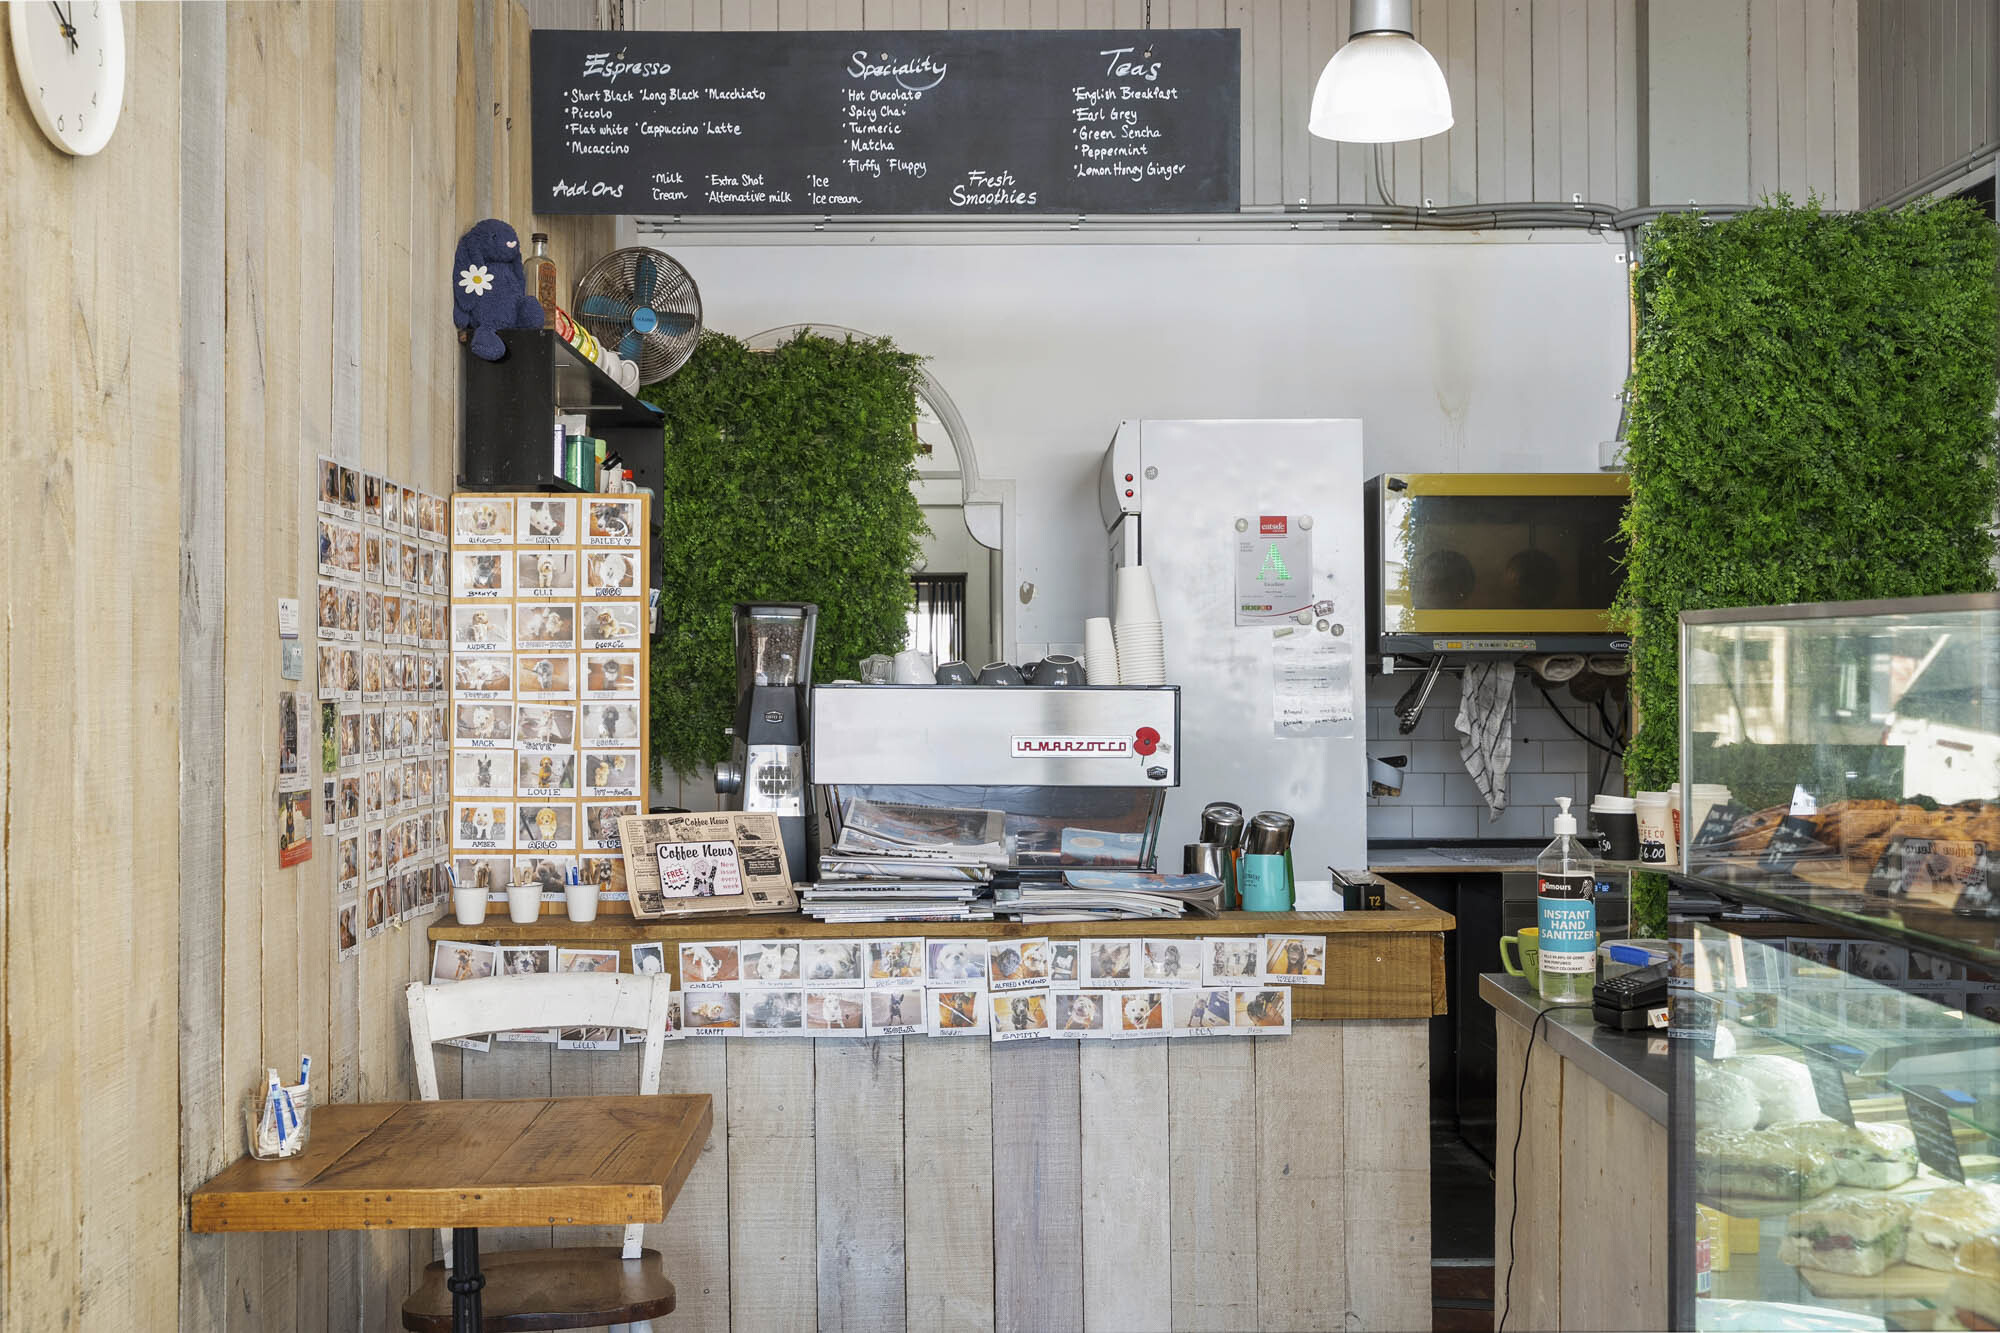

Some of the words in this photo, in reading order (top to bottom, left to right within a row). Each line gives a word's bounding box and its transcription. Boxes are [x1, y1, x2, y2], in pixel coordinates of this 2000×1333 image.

[583, 52, 671, 83] Espresso
[847, 51, 947, 90] Speciality
[1100, 47, 1161, 81] Teas
[571, 89, 600, 103] Short
[603, 90, 633, 102] Black
[641, 89, 666, 105] Long
[670, 88, 699, 100] Black
[709, 88, 765, 100] Macchiato
[849, 89, 865, 101] Hot
[870, 88, 923, 102] Chocolate
[1075, 87, 1117, 106] English
[1120, 87, 1178, 100] Breakfast
[572, 107, 612, 119] Piccolo
[849, 105, 877, 121] Spicy
[880, 103, 906, 117] Chai
[1075, 108, 1105, 121] Earl
[1111, 108, 1137, 126] Grey
[570, 123, 596, 134] Flat
[600, 124, 628, 135] white
[641, 122, 698, 137] Cappuccino
[707, 121, 741, 135] Latte
[849, 122, 901, 134] Turmeric
[1079, 126, 1115, 140] Green
[1122, 124, 1161, 139] Sencha
[572, 141, 629, 154] Mocaccino
[852, 139, 894, 152] Matcha
[1082, 144, 1148, 159] Peppermint
[848, 158, 880, 178] Fluffy
[889, 158, 926, 178] Fluppy
[1076, 163, 1112, 177] Lemon
[1114, 162, 1143, 182] Honey
[1147, 162, 1185, 180] Ginger
[656, 172, 683, 184] Milk
[712, 174, 739, 186] Extra
[742, 174, 764, 186] Shot
[813, 175, 829, 187] Ice
[968, 170, 1015, 189] Fresh
[553, 179, 589, 197] Add
[592, 182, 623, 197] Ons
[653, 188, 688, 200] Cream
[709, 190, 765, 203] Alternative
[769, 191, 792, 202] milk
[813, 193, 827, 204] Ice
[950, 184, 1037, 206] Smoothies
[590, 537, 621, 545] BAILEY
[1256, 543, 1293, 580] A
[684, 818, 709, 827] Coffee
[709, 817, 729, 825] News
[528, 841, 557, 849] ARLO
[660, 846, 699, 860] Coffee
[702, 844, 734, 858] News
[666, 869, 684, 879] FREE
[1369, 896, 1381, 906] T2
[1544, 910, 1590, 920] INSTANT
[1551, 920, 1586, 930] HAND
[1542, 929, 1594, 940] SANITIZER
[994, 982, 1017, 990] ALFRED
